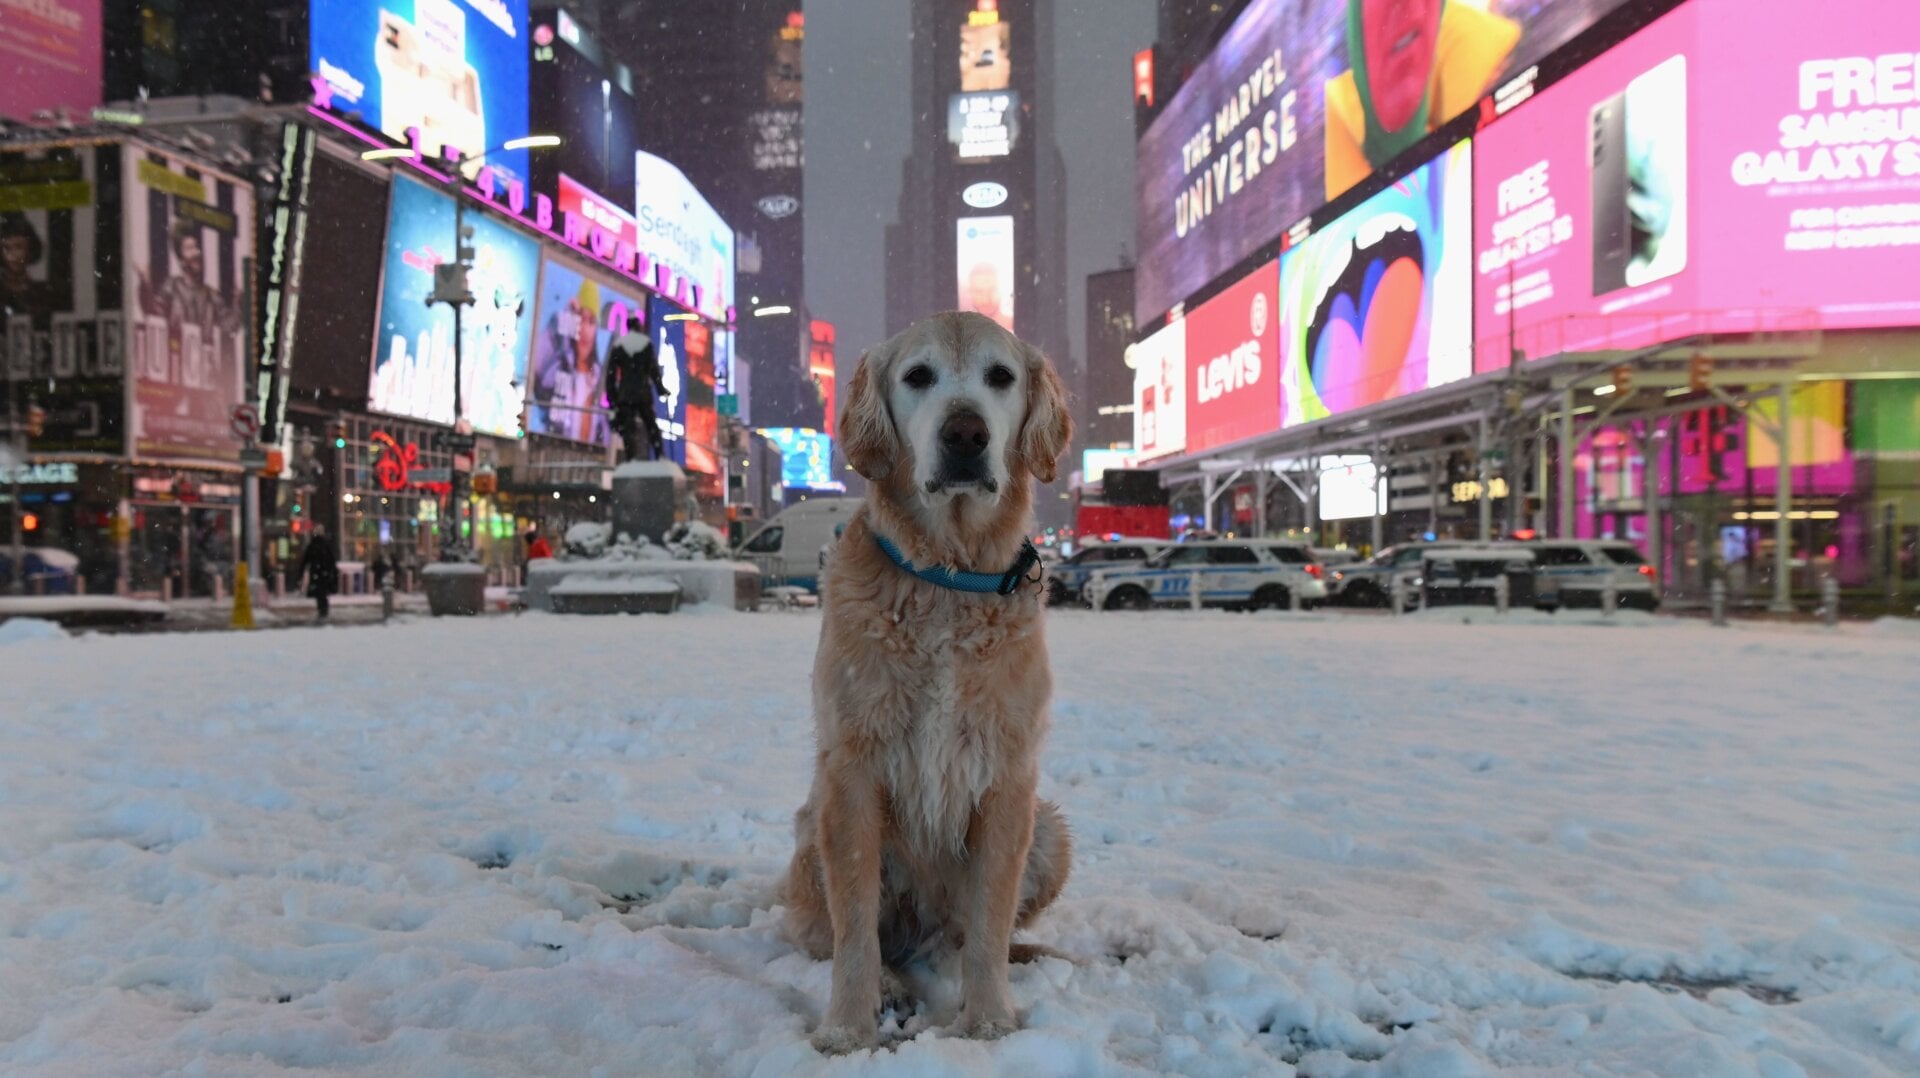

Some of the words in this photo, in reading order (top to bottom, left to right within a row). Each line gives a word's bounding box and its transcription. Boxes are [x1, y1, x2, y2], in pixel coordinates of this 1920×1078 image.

[1798, 52, 1920, 111] FRE
[1182, 122, 1212, 175] THE
[1215, 48, 1287, 144] MARVEL
[1778, 108, 1920, 149] SAMSU
[1175, 88, 1298, 238] UNIVERSE
[1731, 143, 1889, 186] GALAXY
